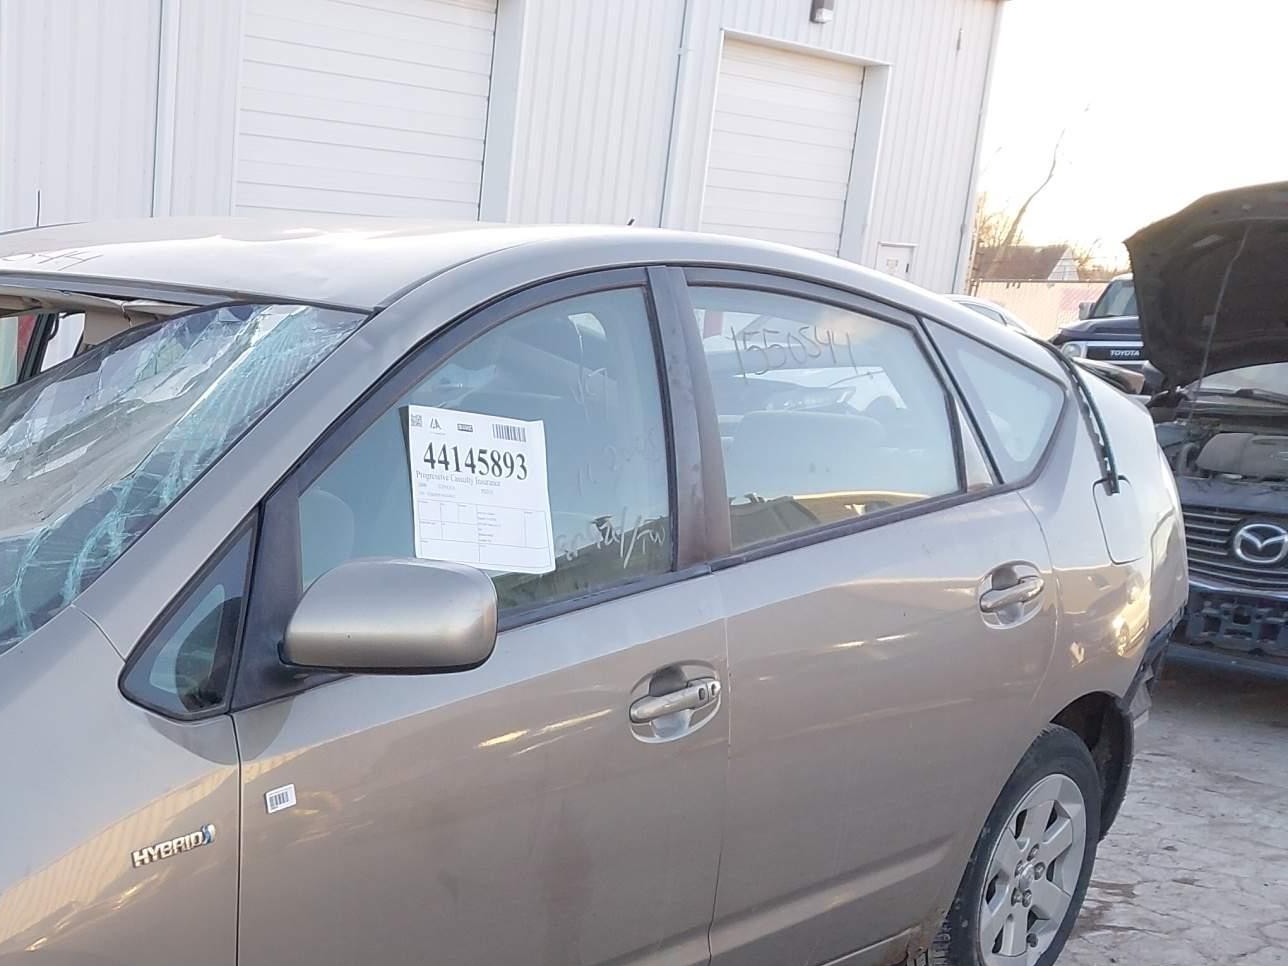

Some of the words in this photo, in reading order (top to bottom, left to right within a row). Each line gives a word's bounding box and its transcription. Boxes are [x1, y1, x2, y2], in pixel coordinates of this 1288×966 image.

[416, 470, 449, 481] Progressive
[450, 474, 474, 485] Casualty
[475, 477, 501, 487] Insurance
[423, 441, 528, 480] 44145893
[132, 831, 203, 867] HYBRID
